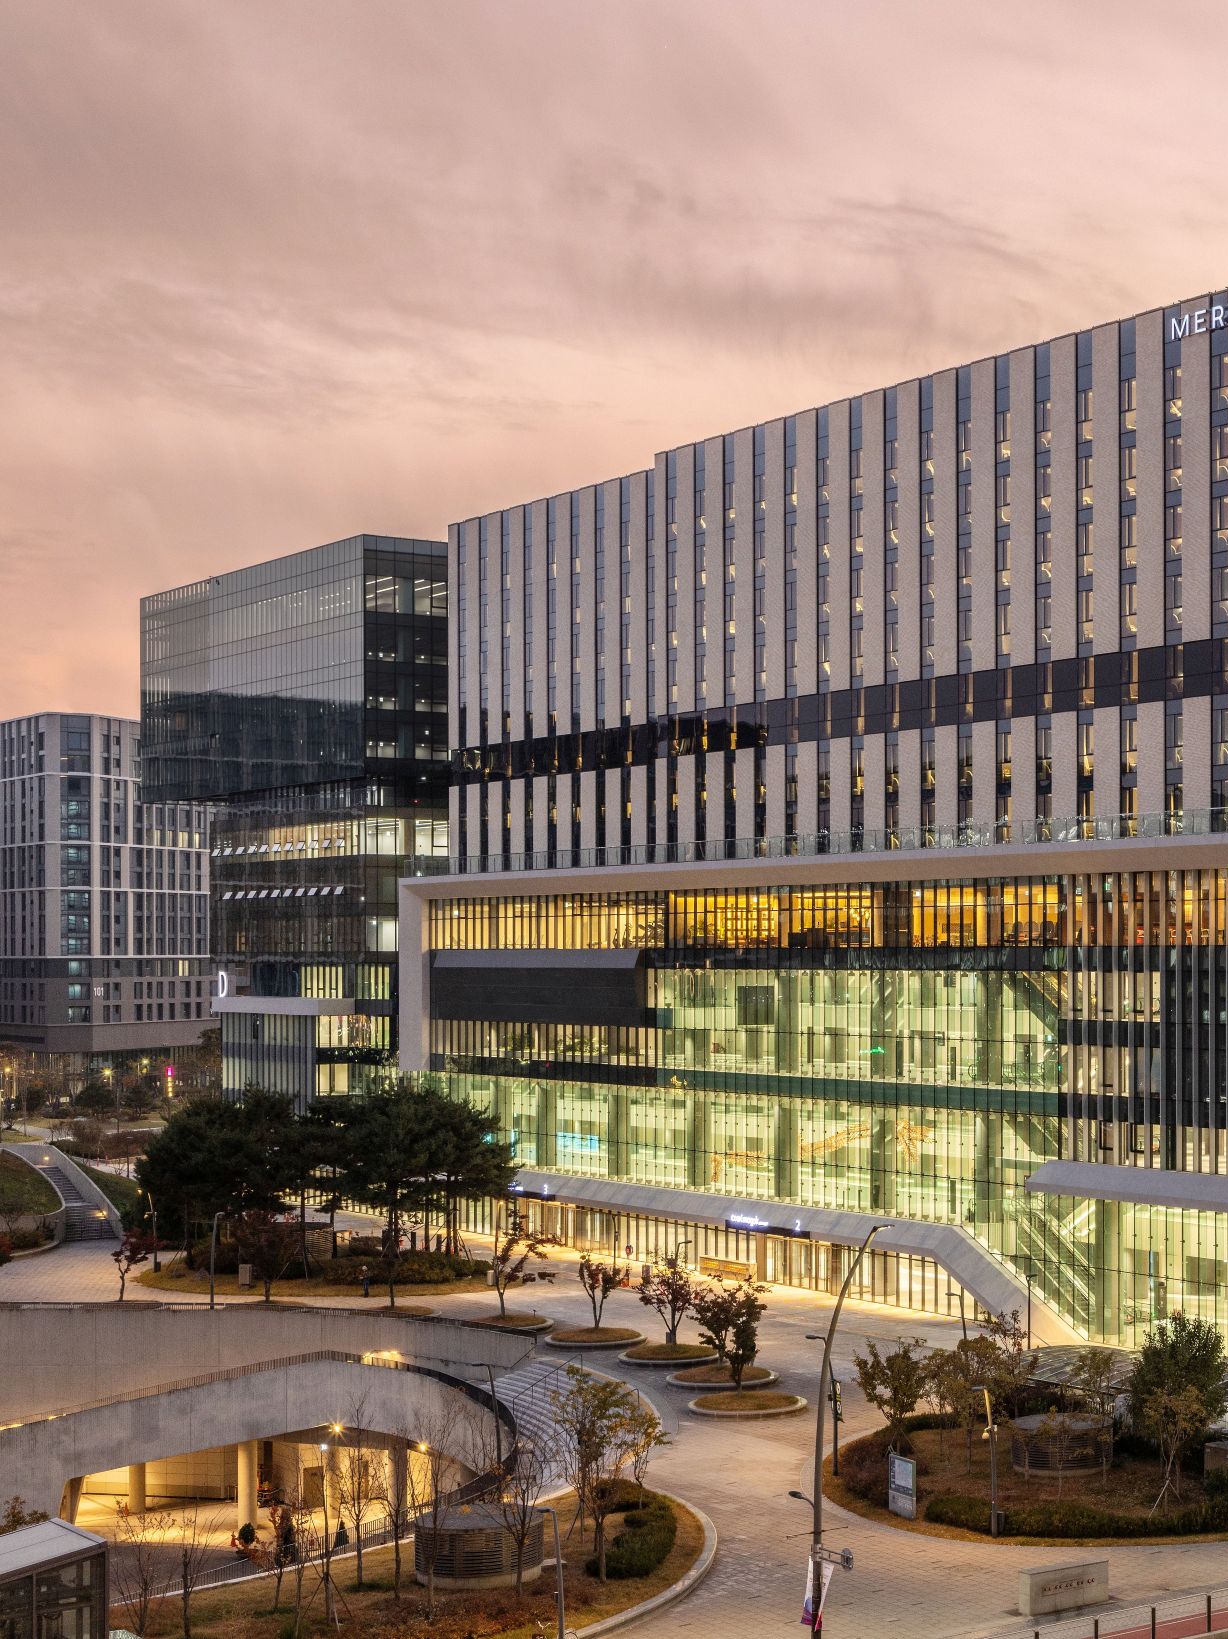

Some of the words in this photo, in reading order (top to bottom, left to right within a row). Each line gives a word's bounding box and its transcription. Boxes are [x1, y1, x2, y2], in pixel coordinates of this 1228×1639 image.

[219, 971, 227, 997] D
[93, 987, 104, 997] 101
[795, 1219, 801, 1231] 2
